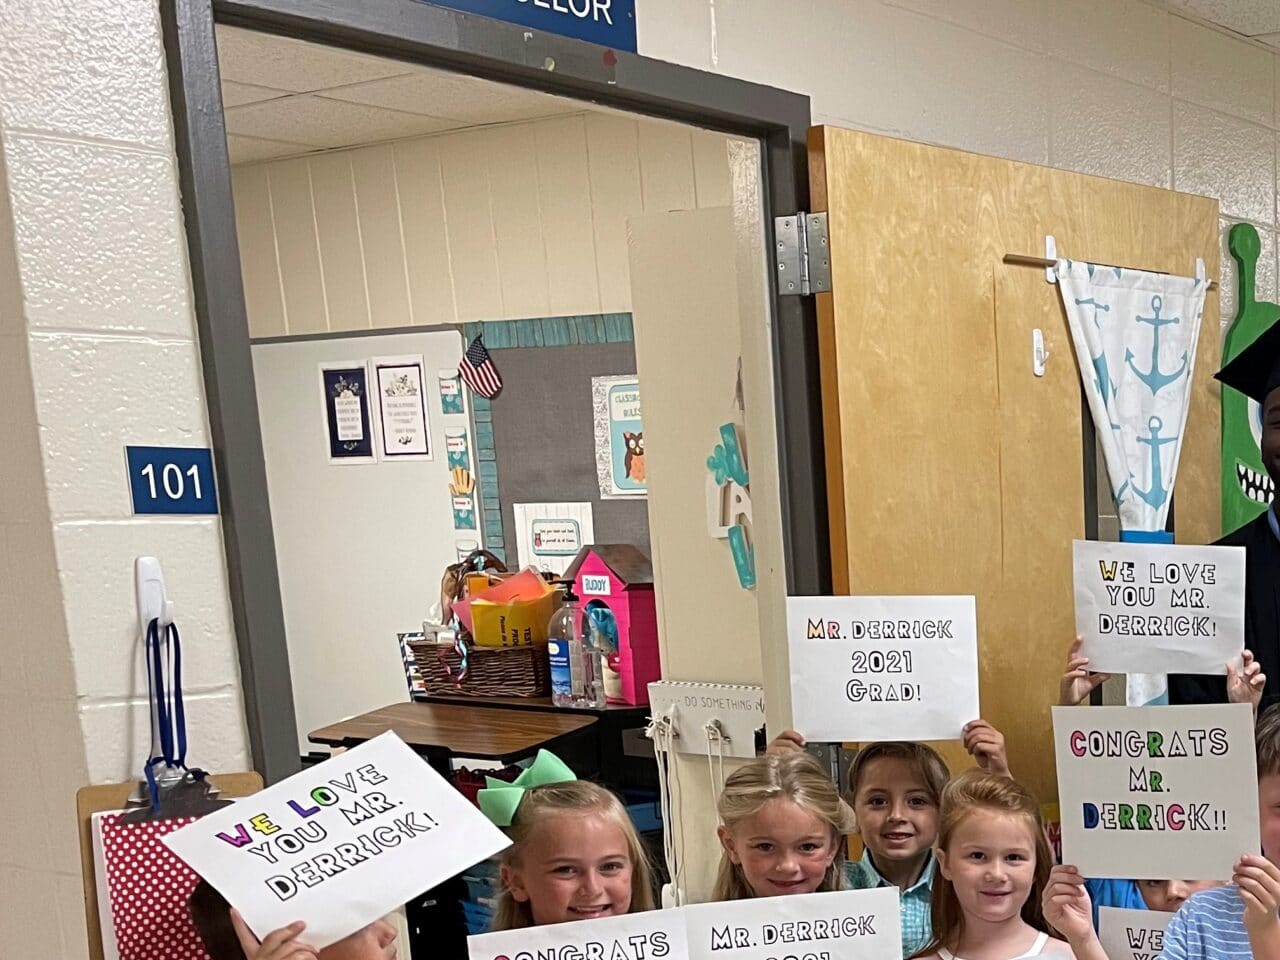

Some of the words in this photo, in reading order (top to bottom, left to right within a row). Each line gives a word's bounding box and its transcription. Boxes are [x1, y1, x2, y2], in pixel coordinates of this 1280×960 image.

[141, 463, 201, 499] 101
[1099, 560, 1135, 583] WE
[1150, 563, 1216, 585] LOVE
[1106, 586, 1155, 607] YOU
[1170, 588, 1210, 609] MR.
[807, 618, 846, 639] MR.
[852, 620, 953, 639] DERRICK
[1099, 614, 1217, 637] DERRICK!
[852, 650, 912, 673] 2021
[701, 697, 752, 710] SOMETHING
[846, 679, 921, 702] GRAD!
[1070, 728, 1229, 758] CONGRATS
[1129, 766, 1170, 793] MR.
[215, 812, 281, 848] WE
[287, 764, 388, 819] LOVE
[1083, 802, 1227, 831] DERRICK!!
[248, 821, 327, 864] YOU
[339, 791, 403, 825] MR.
[265, 812, 439, 901] DERRICK!
[711, 923, 758, 951] MR.
[763, 914, 876, 944] DERRICK
[1126, 928, 1164, 951] WE
